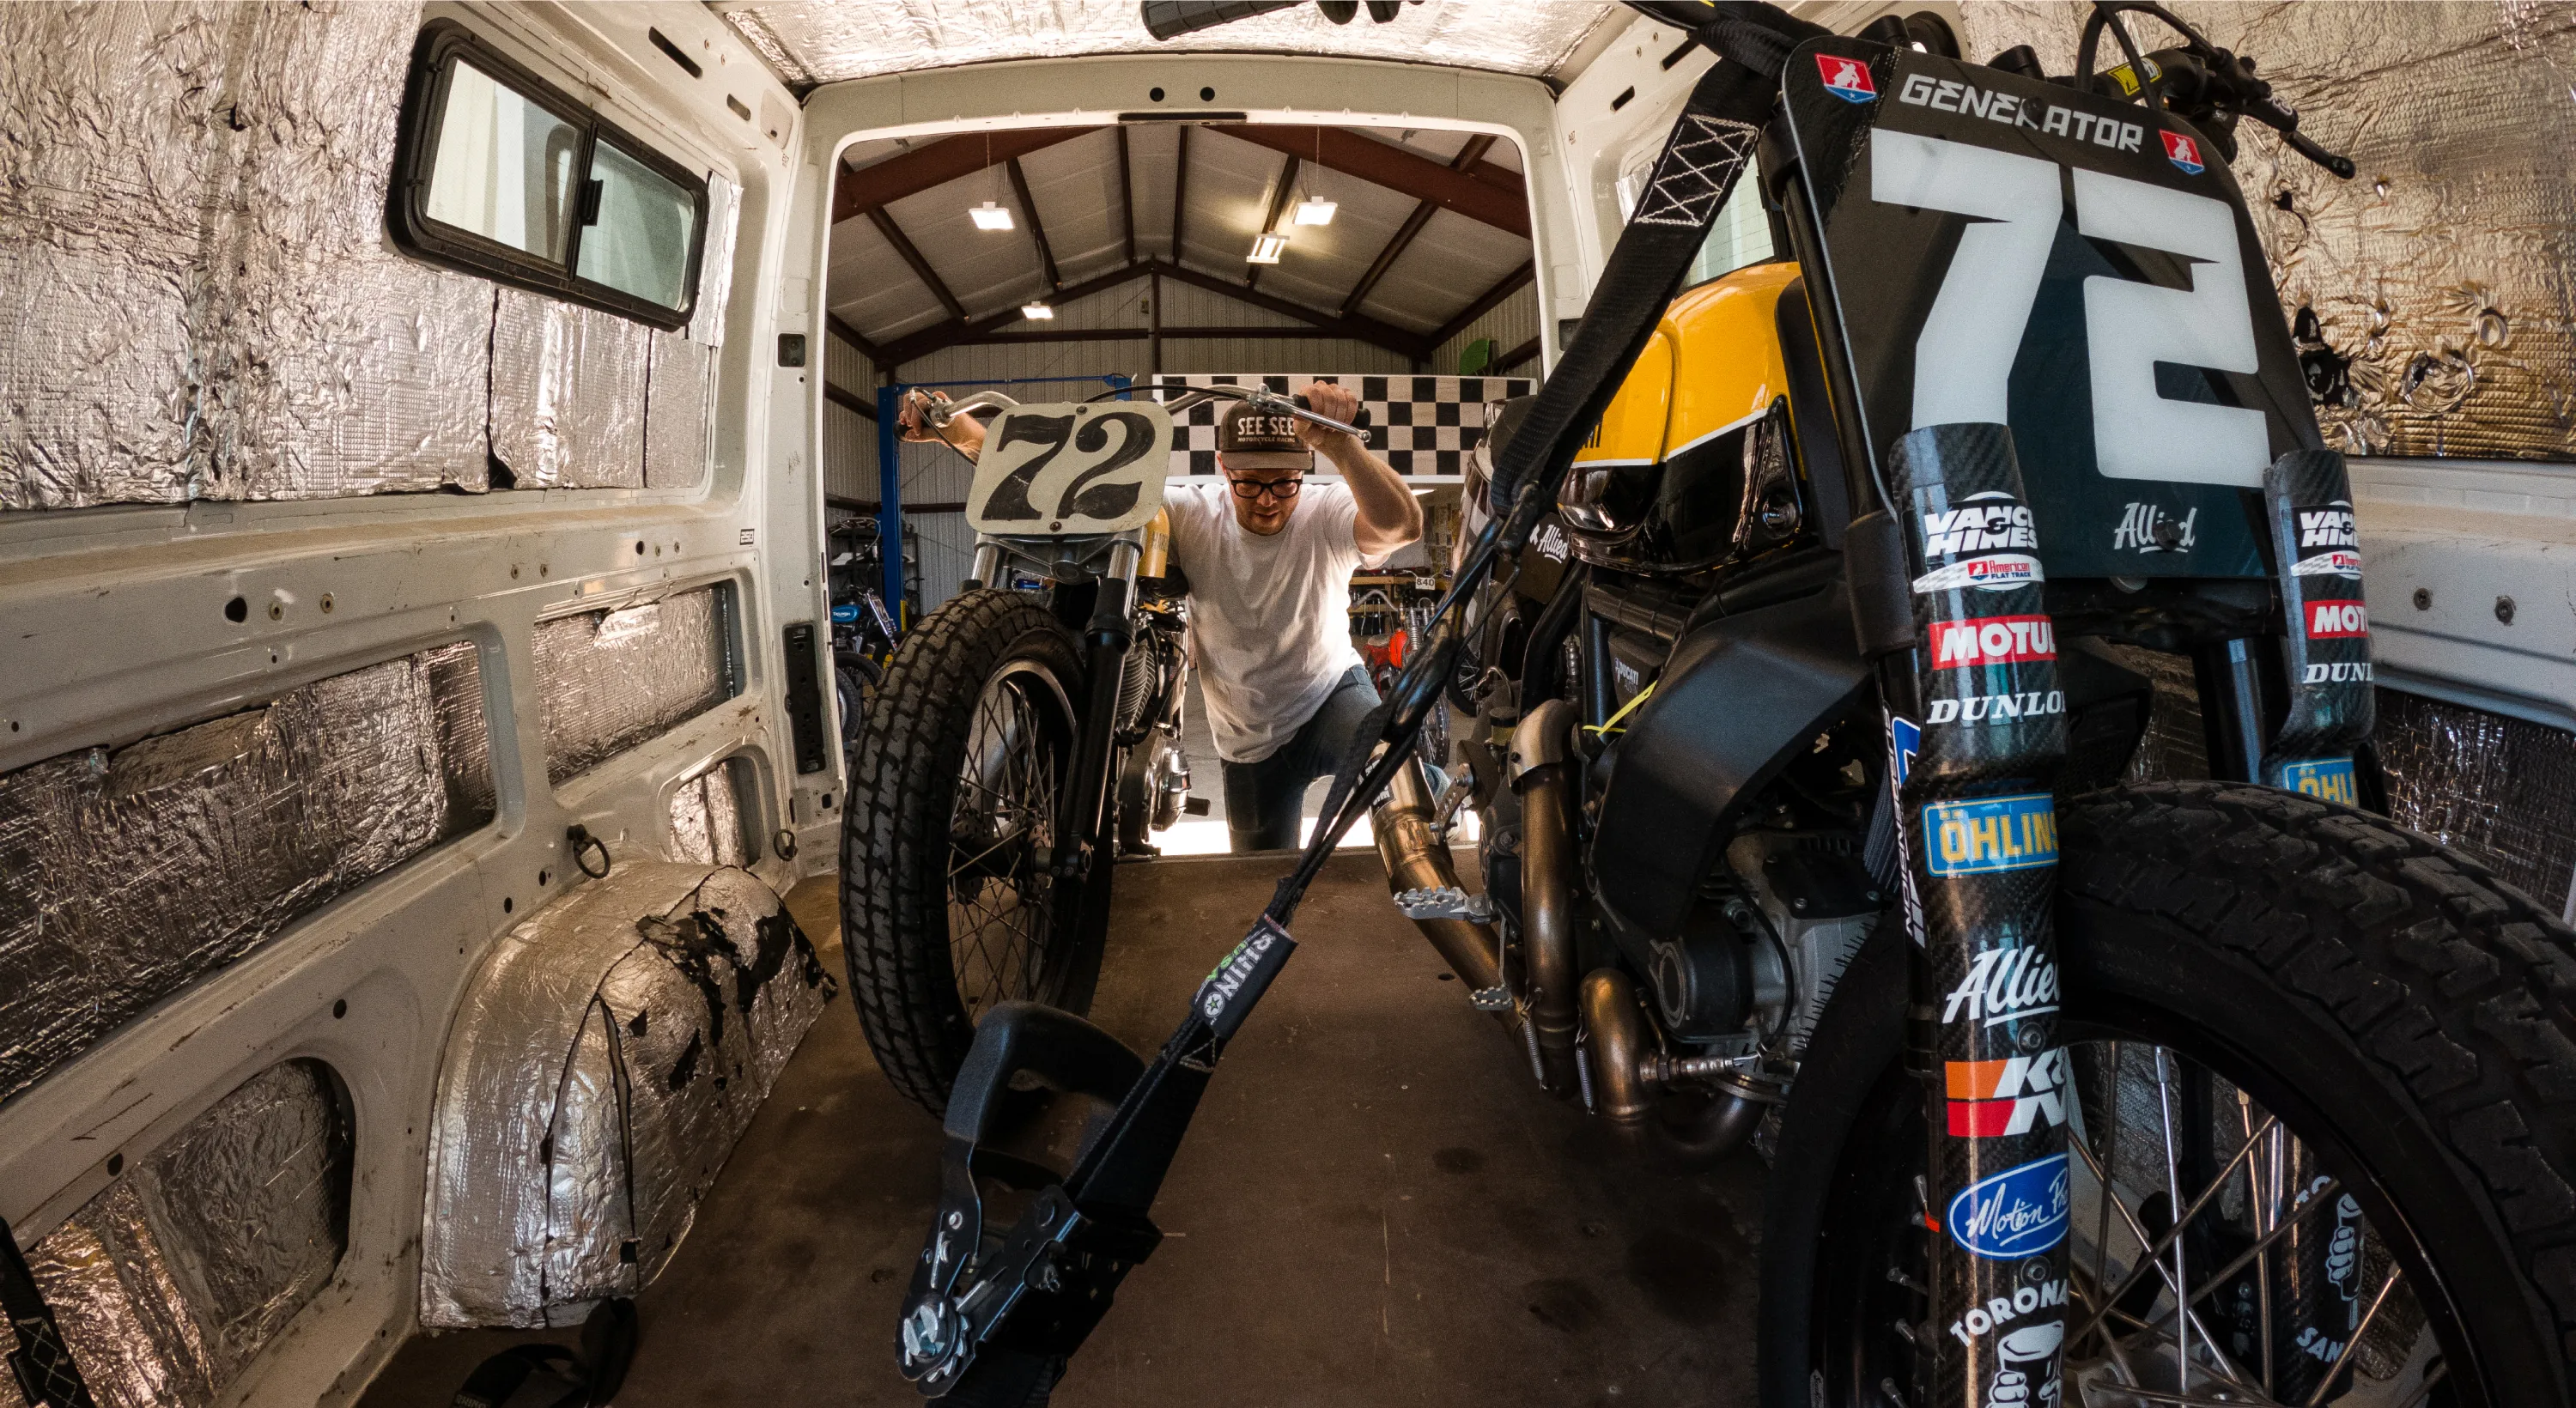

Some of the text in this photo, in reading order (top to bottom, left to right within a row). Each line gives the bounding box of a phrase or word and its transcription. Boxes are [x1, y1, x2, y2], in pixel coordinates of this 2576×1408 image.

[1871, 127, 2271, 488] 72
[1237, 416, 1296, 436] SEE SEE
[981, 412, 1156, 520] 72
[1925, 526, 2038, 557] HINES
[2114, 502, 2197, 554] Alld
[2301, 527, 2360, 547] HIN
[1989, 560, 2031, 573] American
[1204, 932, 1276, 1018] RHINO
[1965, 1182, 2050, 1240] Motion
